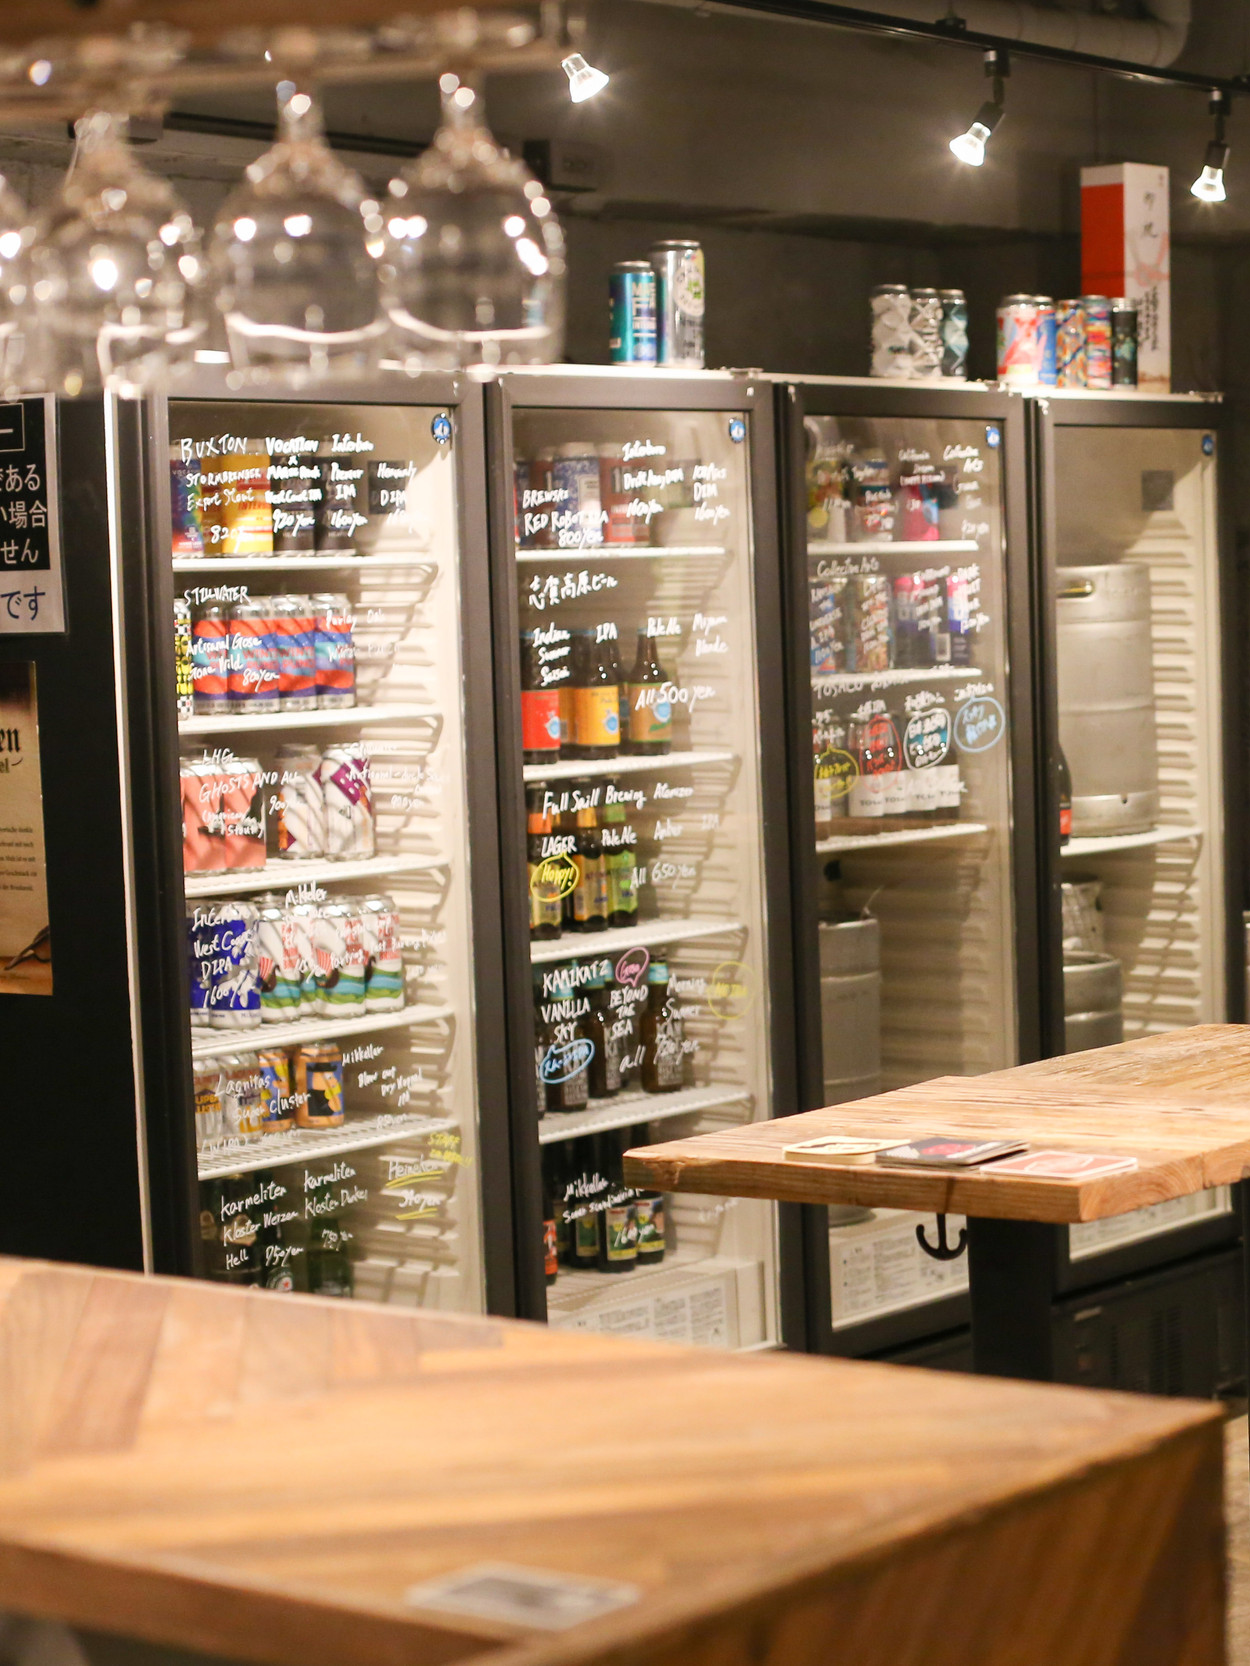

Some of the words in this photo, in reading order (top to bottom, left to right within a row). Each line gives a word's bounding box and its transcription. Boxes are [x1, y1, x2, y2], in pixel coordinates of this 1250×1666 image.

[180, 434, 247, 466] BUXTON
[524, 513, 549, 536] RED
[529, 570, 618, 610] 志賀高原ビール
[596, 622, 618, 644] IPA
[657, 681, 688, 704] 500
[199, 773, 249, 803] GHOSTS
[252, 771, 278, 790] AND
[542, 791, 568, 820] Full
[541, 835, 577, 858] LAGER
[608, 985, 648, 1009] BEYOND
[611, 1019, 634, 1041] SEA
[225, 1249, 249, 1271] Hell
